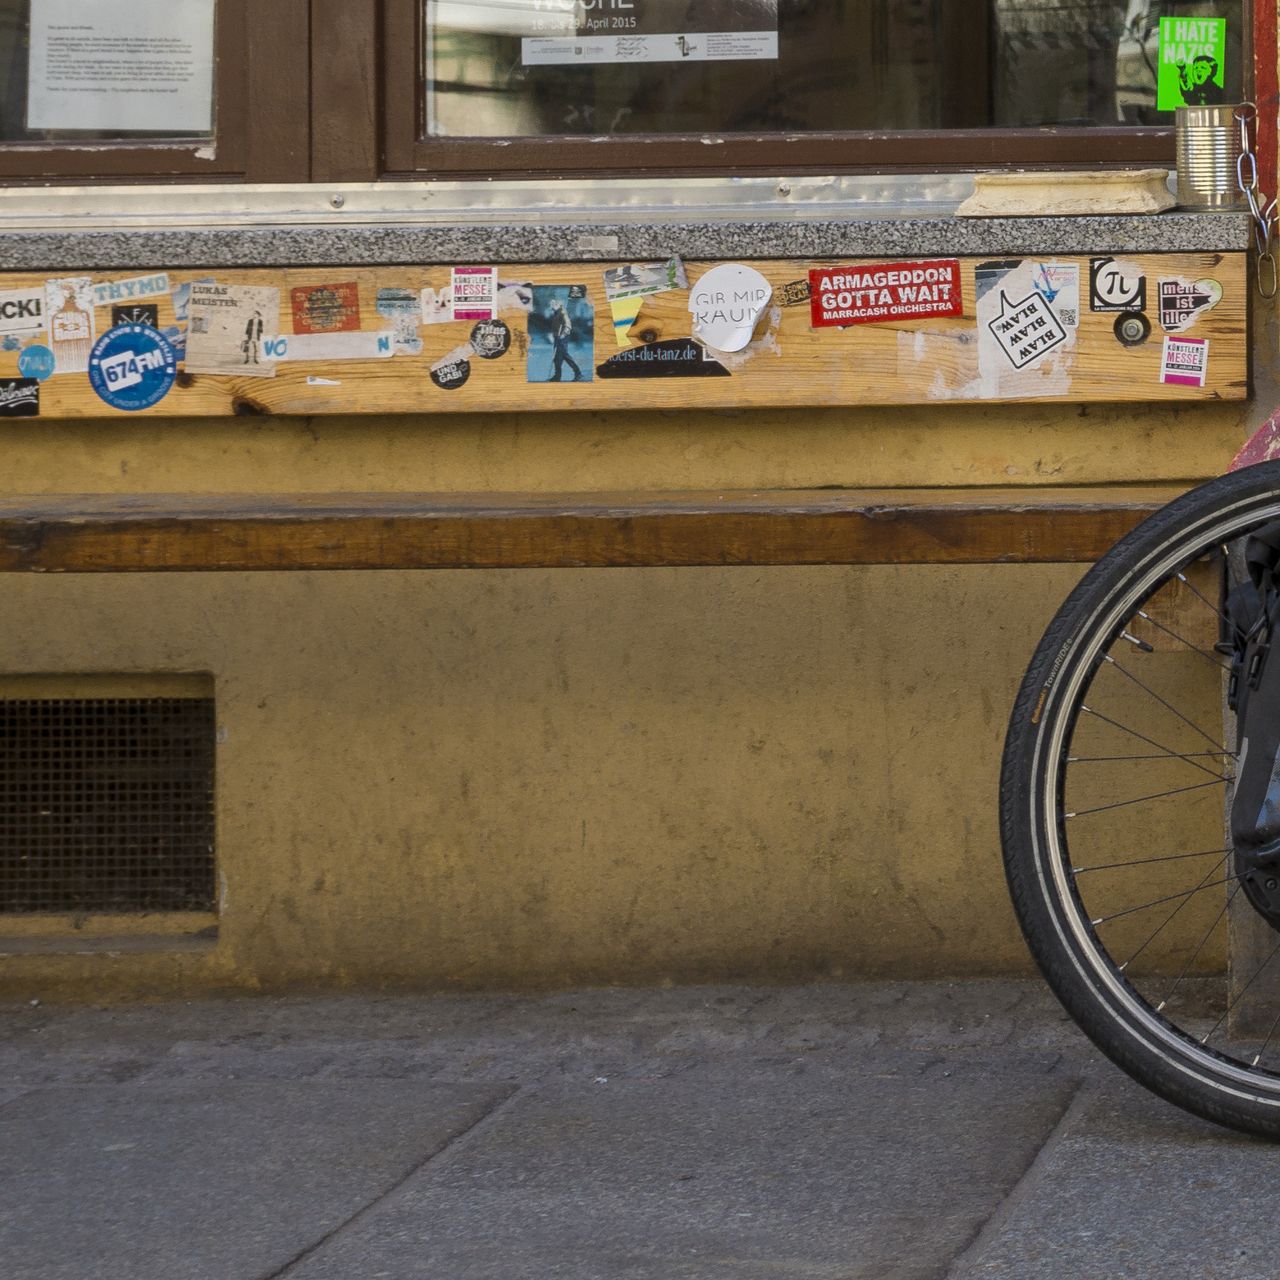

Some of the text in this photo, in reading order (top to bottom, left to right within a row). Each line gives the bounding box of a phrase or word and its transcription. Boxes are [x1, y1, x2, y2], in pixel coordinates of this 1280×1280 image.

[586, 17, 609, 30] April
[612, 17, 637, 28] 2015
[1164, 21, 1219, 43] I HATE
[819, 266, 953, 291] ARMAGEDDON
[94, 275, 168, 302] THYMO
[191, 286, 228, 295] LUKAS
[454, 284, 487, 296] MESSE
[821, 283, 953, 310] GOTTA WAIT
[191, 297, 239, 308] MEISTER
[1176, 296, 1195, 308] ist
[823, 302, 953, 320] MARRACASH ORCHESTRA
[1000, 302, 1039, 334] BLAW
[1009, 315, 1047, 347] BLAW
[1019, 329, 1057, 360] BLAW
[1167, 344, 1200, 354] KÜNSTLER
[105, 348, 166, 384] 674FM
[1166, 351, 1198, 365] MESSE
[437, 364, 457, 376] UND
[439, 372, 463, 383] GABI
